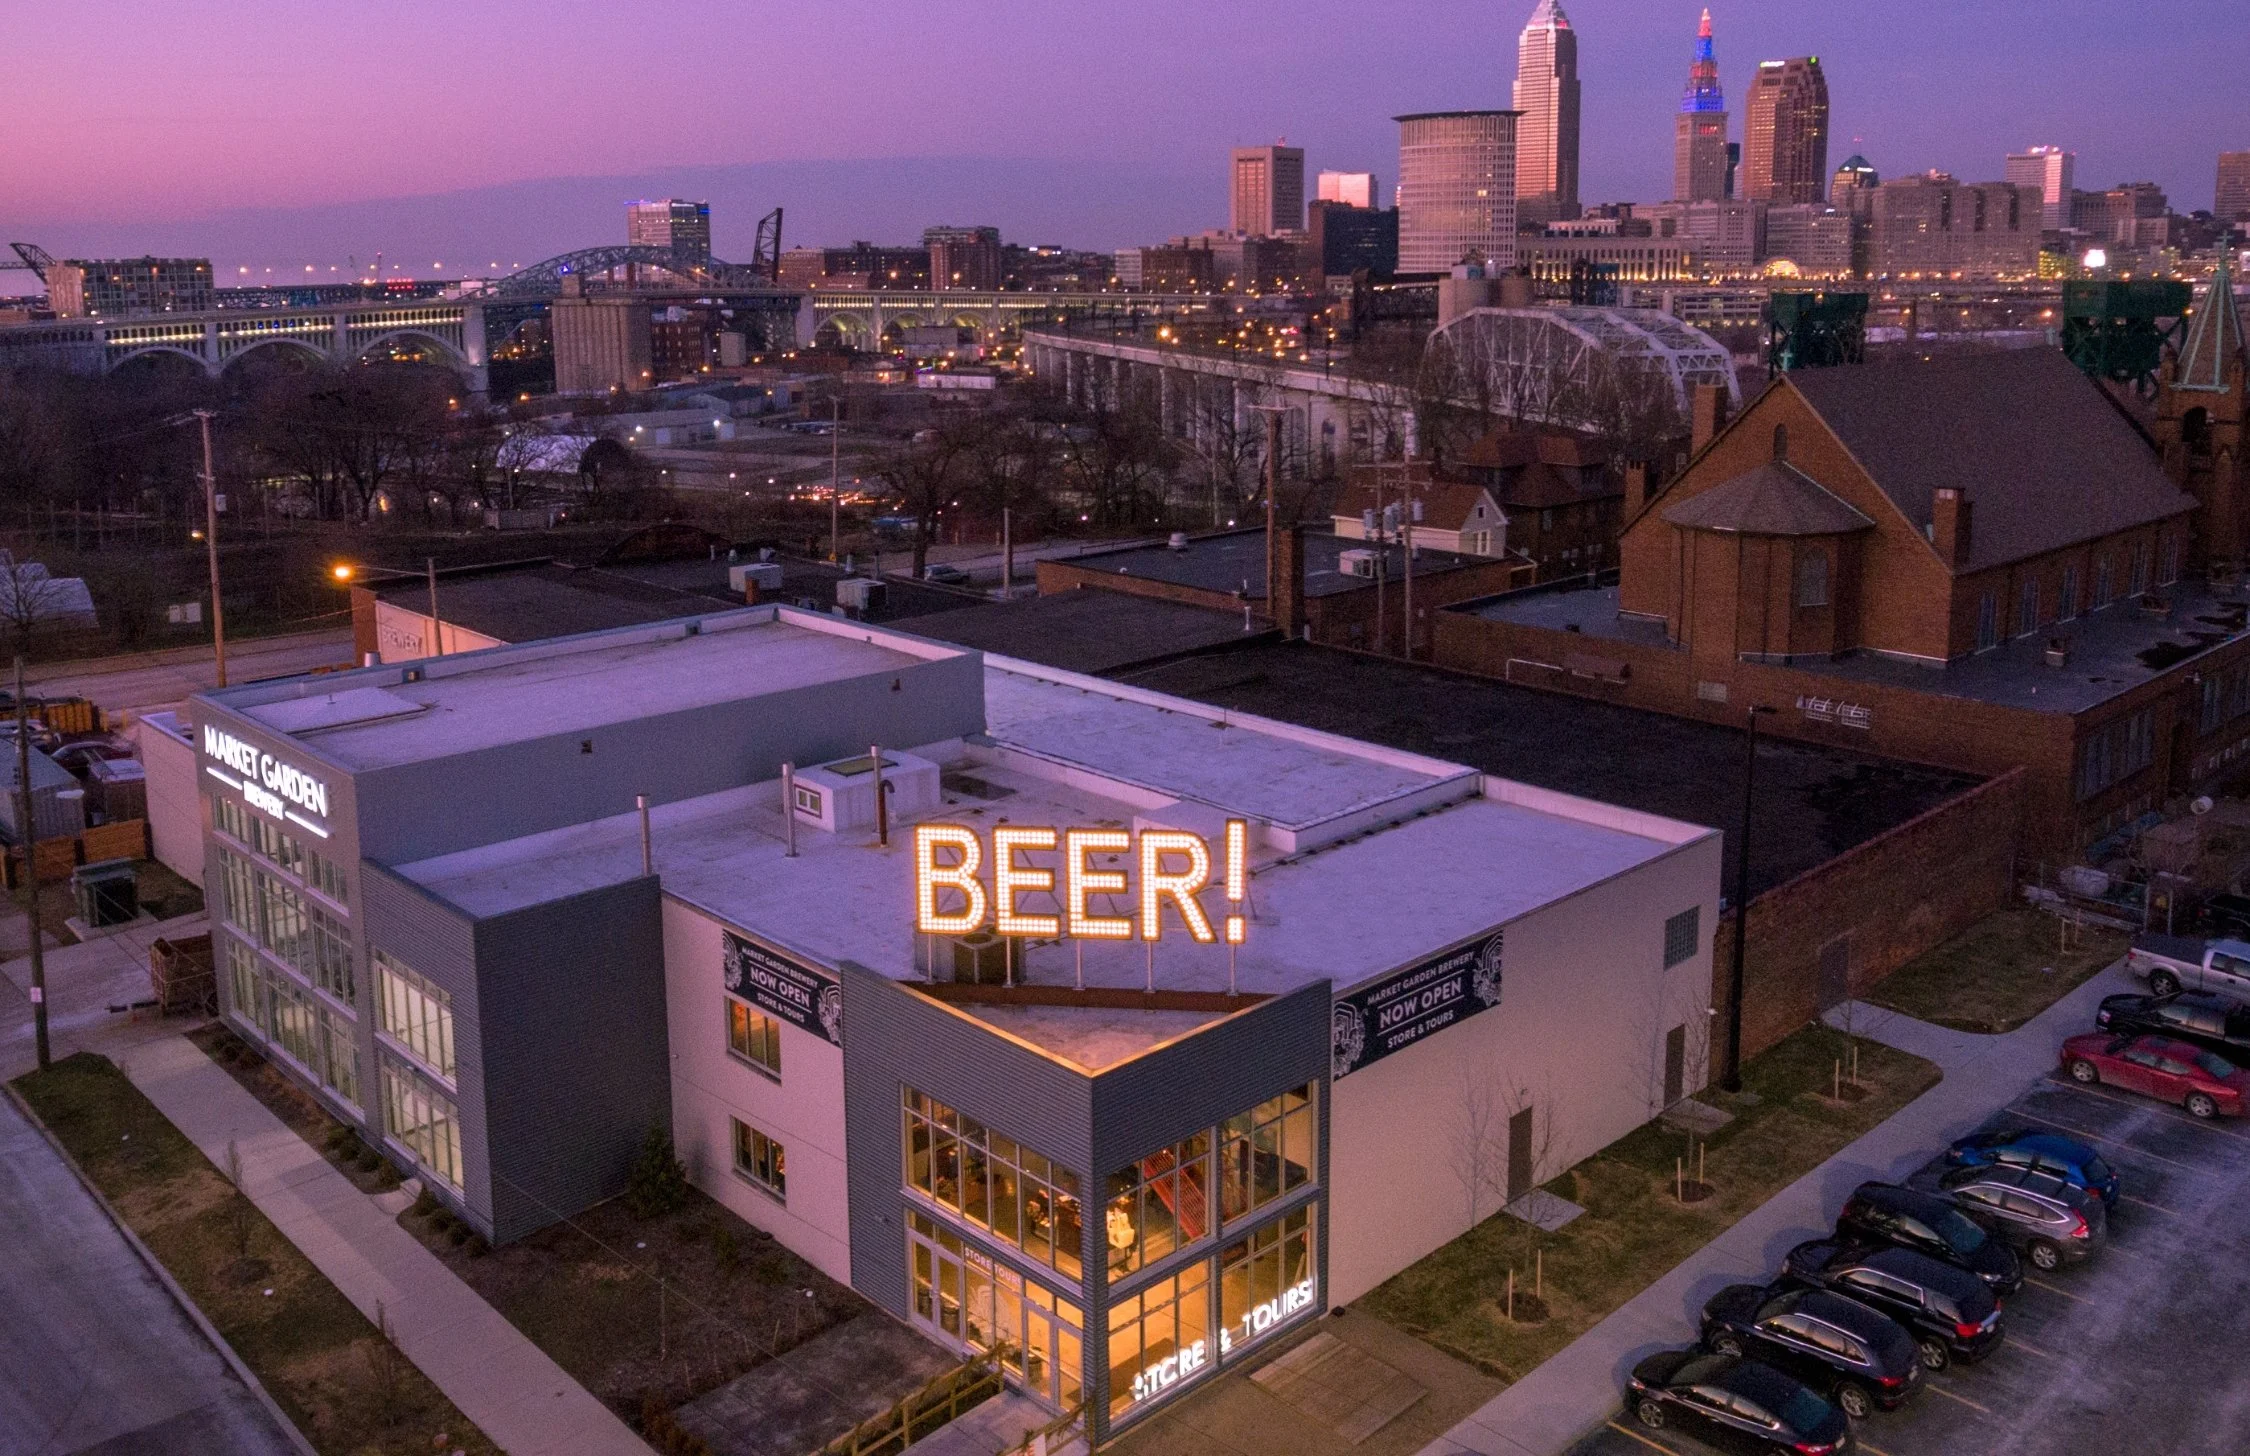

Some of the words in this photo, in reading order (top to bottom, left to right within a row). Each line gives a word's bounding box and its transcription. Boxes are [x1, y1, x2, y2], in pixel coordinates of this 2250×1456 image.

[204, 724, 258, 780] MARKET
[260, 754, 328, 818] GARDEN
[913, 818, 1248, 944] BEER!
[741, 946, 765, 962] MARKET
[765, 957, 790, 975] GARDEN
[790, 968, 818, 988] BREWERY
[750, 966, 777, 990] NOW
[779, 981, 810, 1008] OPEN
[1367, 982, 1401, 1005] MARKET
[1402, 967, 1437, 989] GARDEN
[1438, 951, 1474, 974] BREWERY
[757, 992, 777, 1009] STORE
[783, 1005, 805, 1023] TOURS
[1379, 997, 1417, 1029] NOW
[1421, 976, 1462, 1008] OPEN
[1387, 1026, 1416, 1049] STORE
[1417, 1025, 1424, 1034] &
[1425, 1009, 1454, 1031] TOURS
[1242, 1277, 1314, 1337] TOURS
